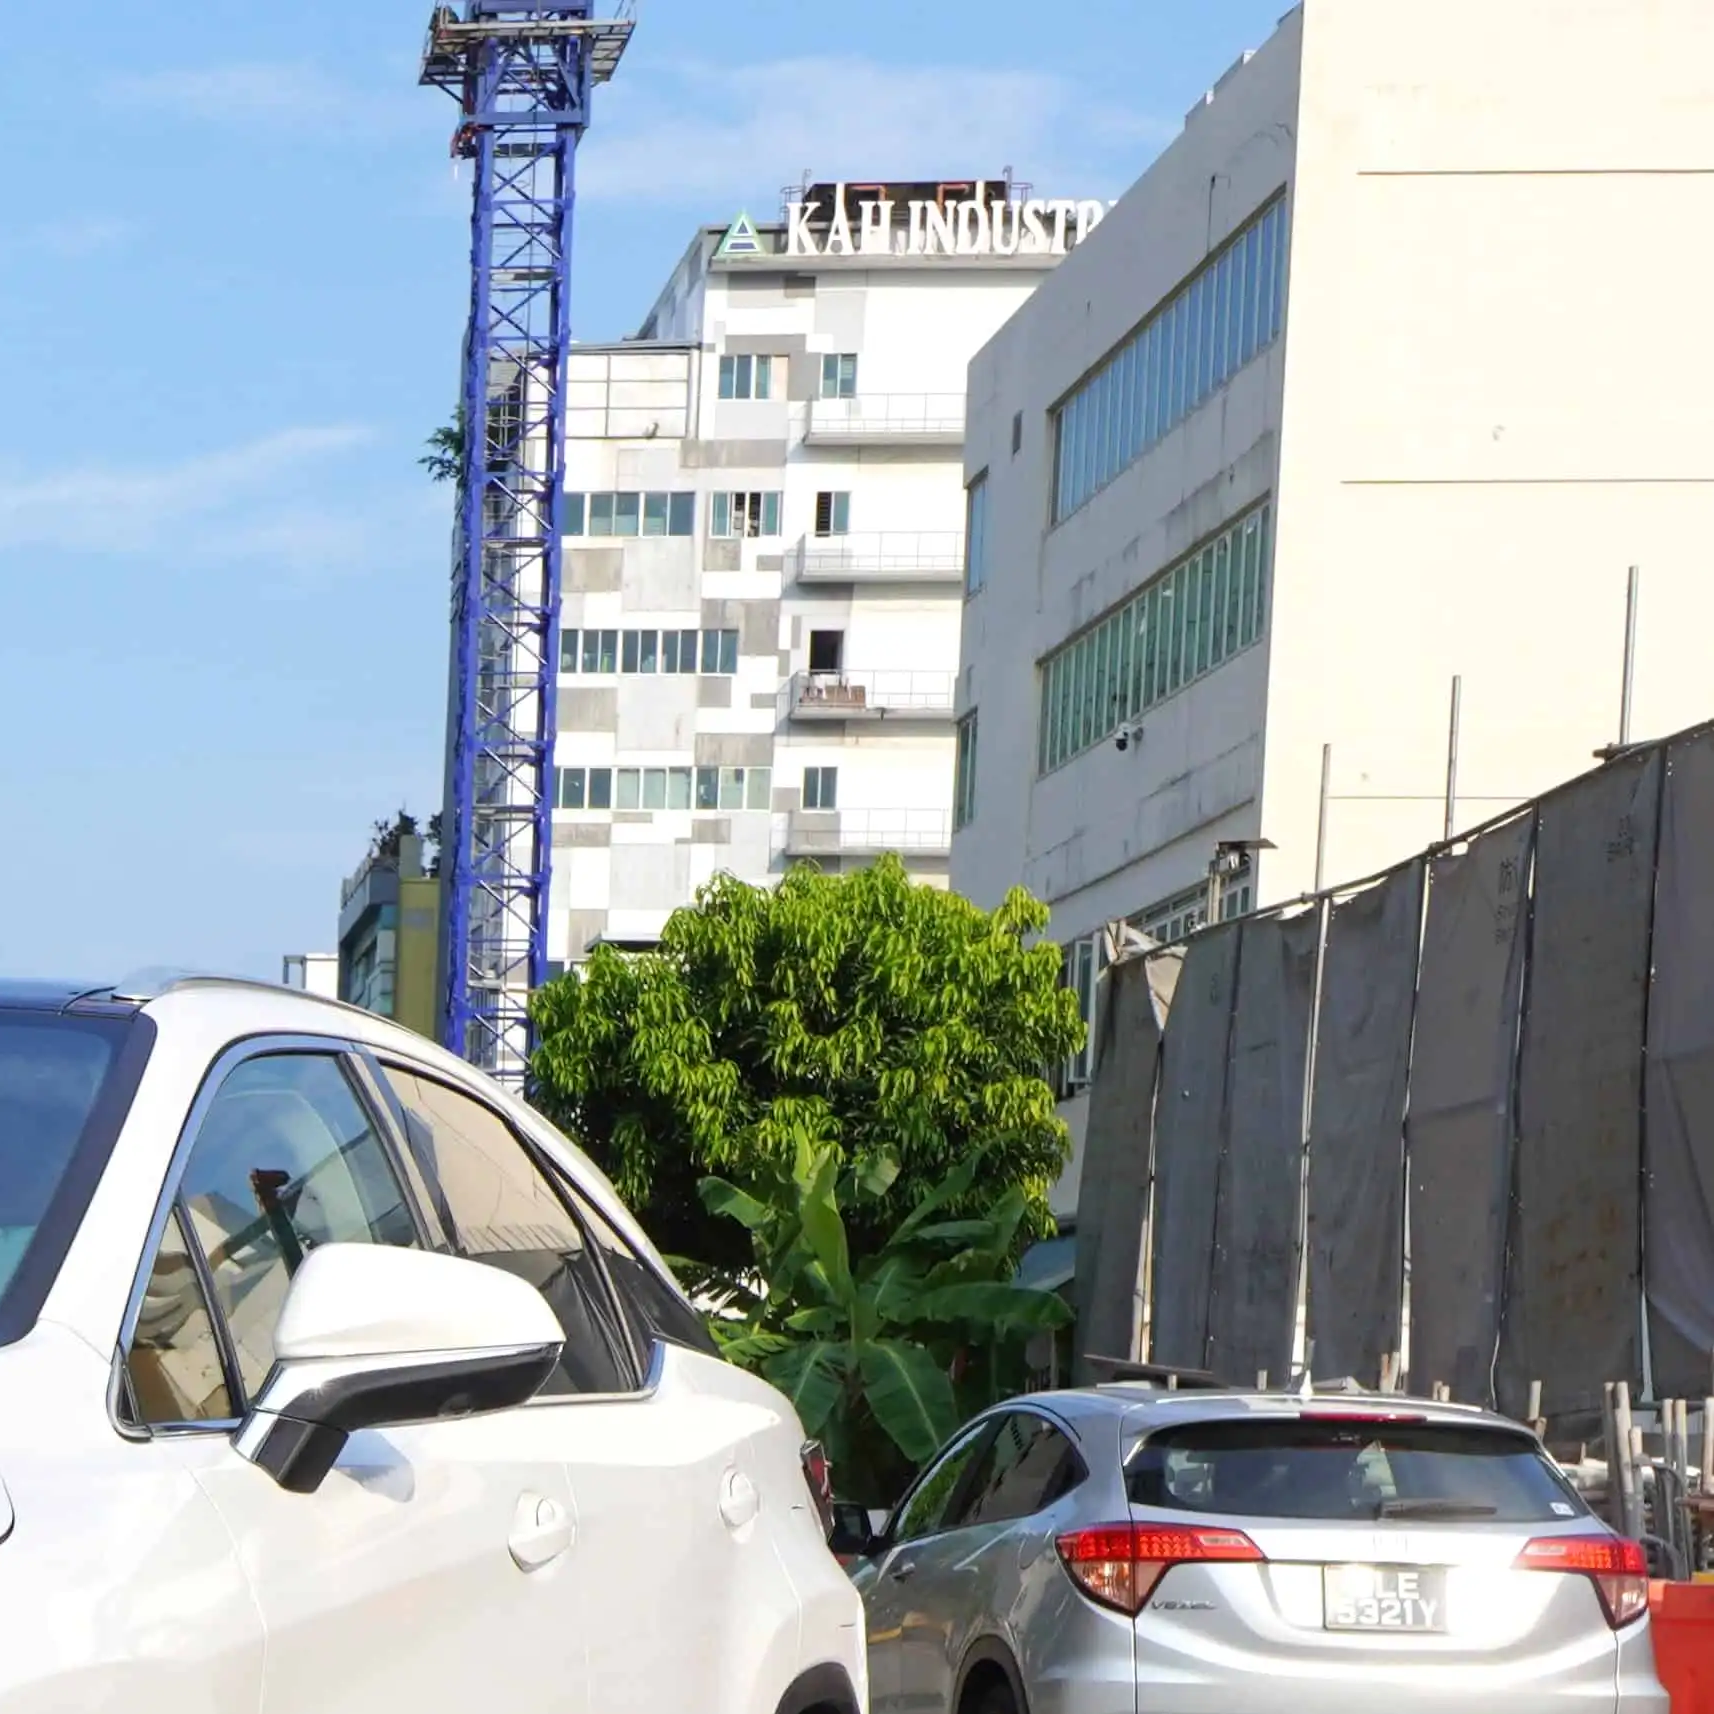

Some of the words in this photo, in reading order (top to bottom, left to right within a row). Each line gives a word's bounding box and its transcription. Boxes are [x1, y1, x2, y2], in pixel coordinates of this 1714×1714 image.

[785, 199, 896, 257] KAH
[906, 198, 1119, 257] INDUSTR
[1368, 1571, 1420, 1600] LE
